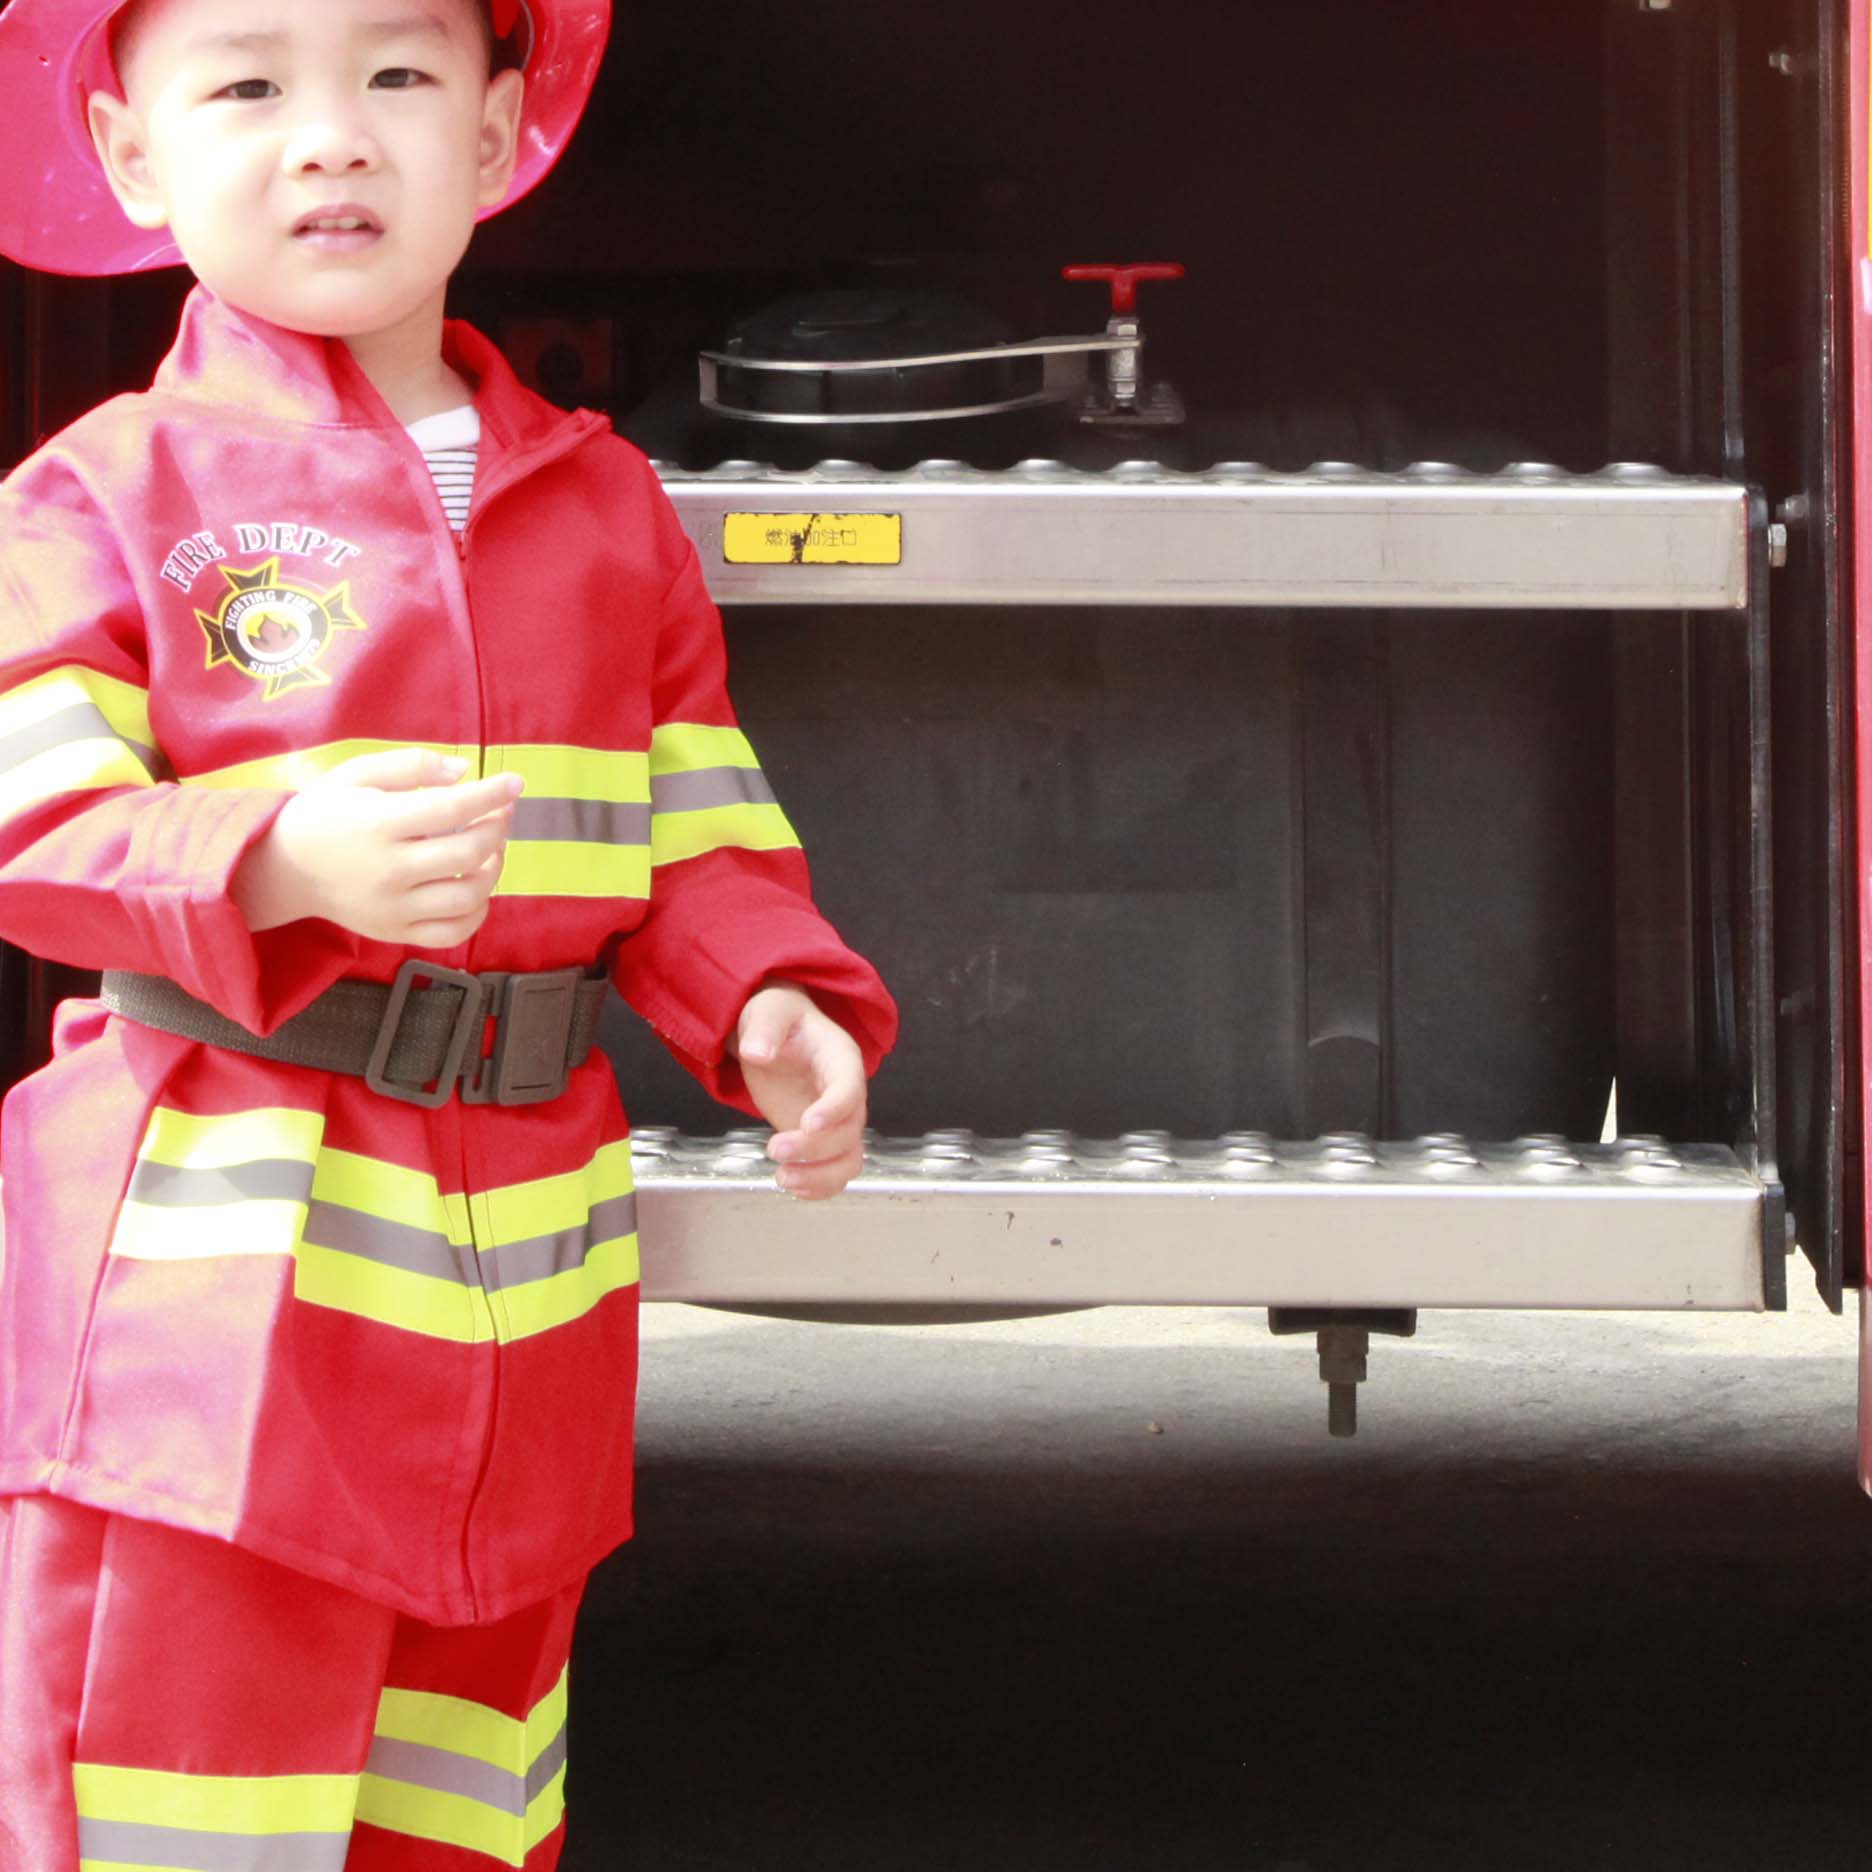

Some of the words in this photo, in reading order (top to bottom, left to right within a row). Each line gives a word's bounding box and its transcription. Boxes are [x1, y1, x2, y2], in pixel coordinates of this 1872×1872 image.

[160, 532, 226, 592] FIRE
[234, 523, 358, 566] DEPT
[225, 590, 277, 630] FIGHTING
